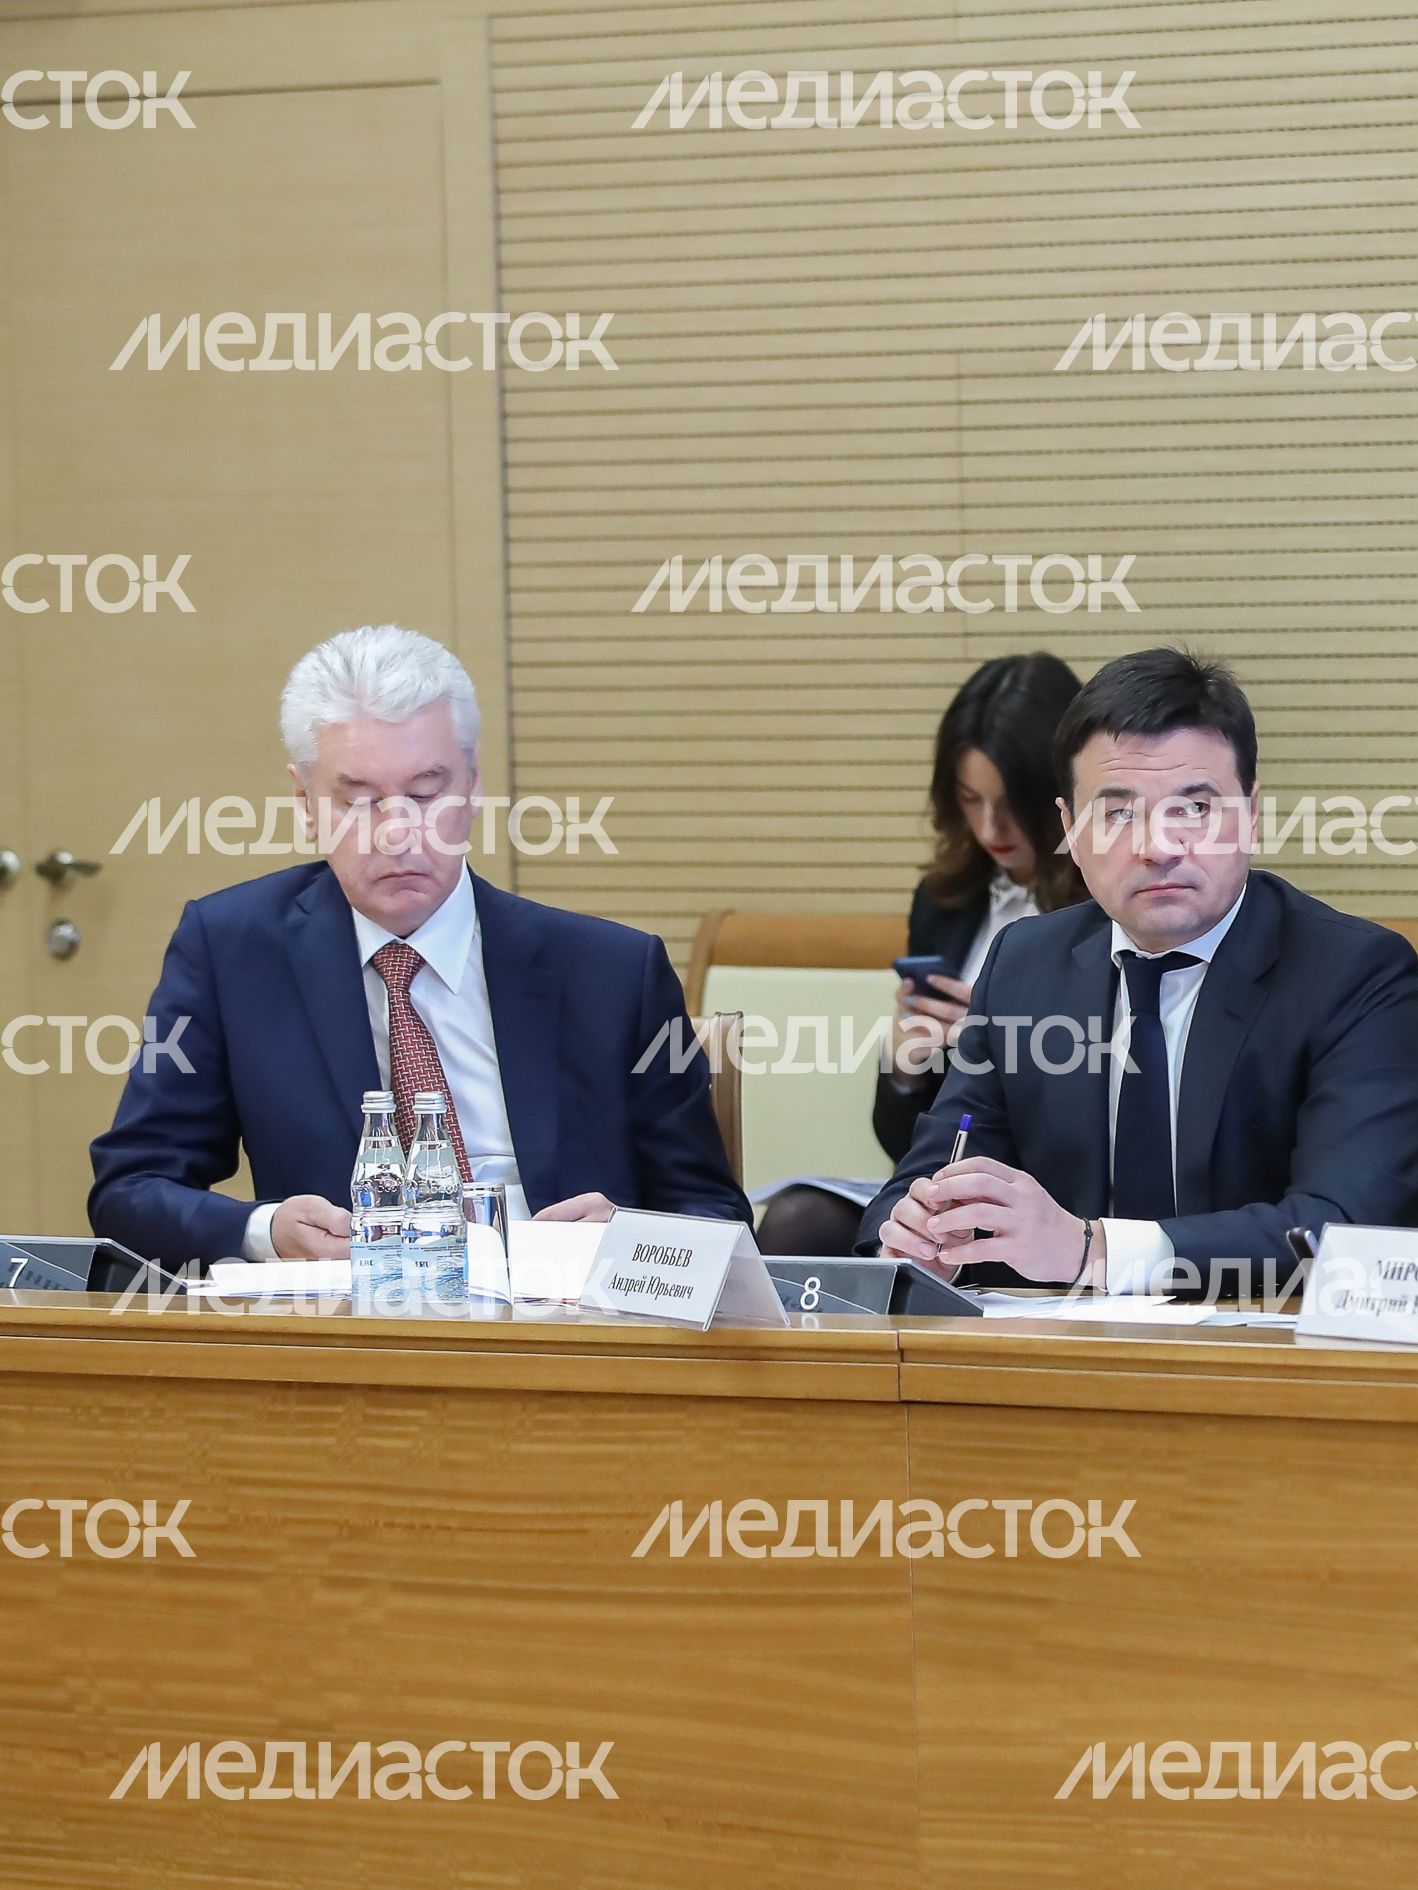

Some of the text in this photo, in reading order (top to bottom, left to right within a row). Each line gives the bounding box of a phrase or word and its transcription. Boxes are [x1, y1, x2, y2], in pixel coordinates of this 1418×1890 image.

[632, 1243, 693, 1268] ВОРОБЬЕВ
[9, 1257, 29, 1288] 7
[608, 1273, 695, 1300] Андрей Юрьевич
[800, 1276, 821, 1310] 8
[1335, 1289, 1408, 1317] Дмитрий
